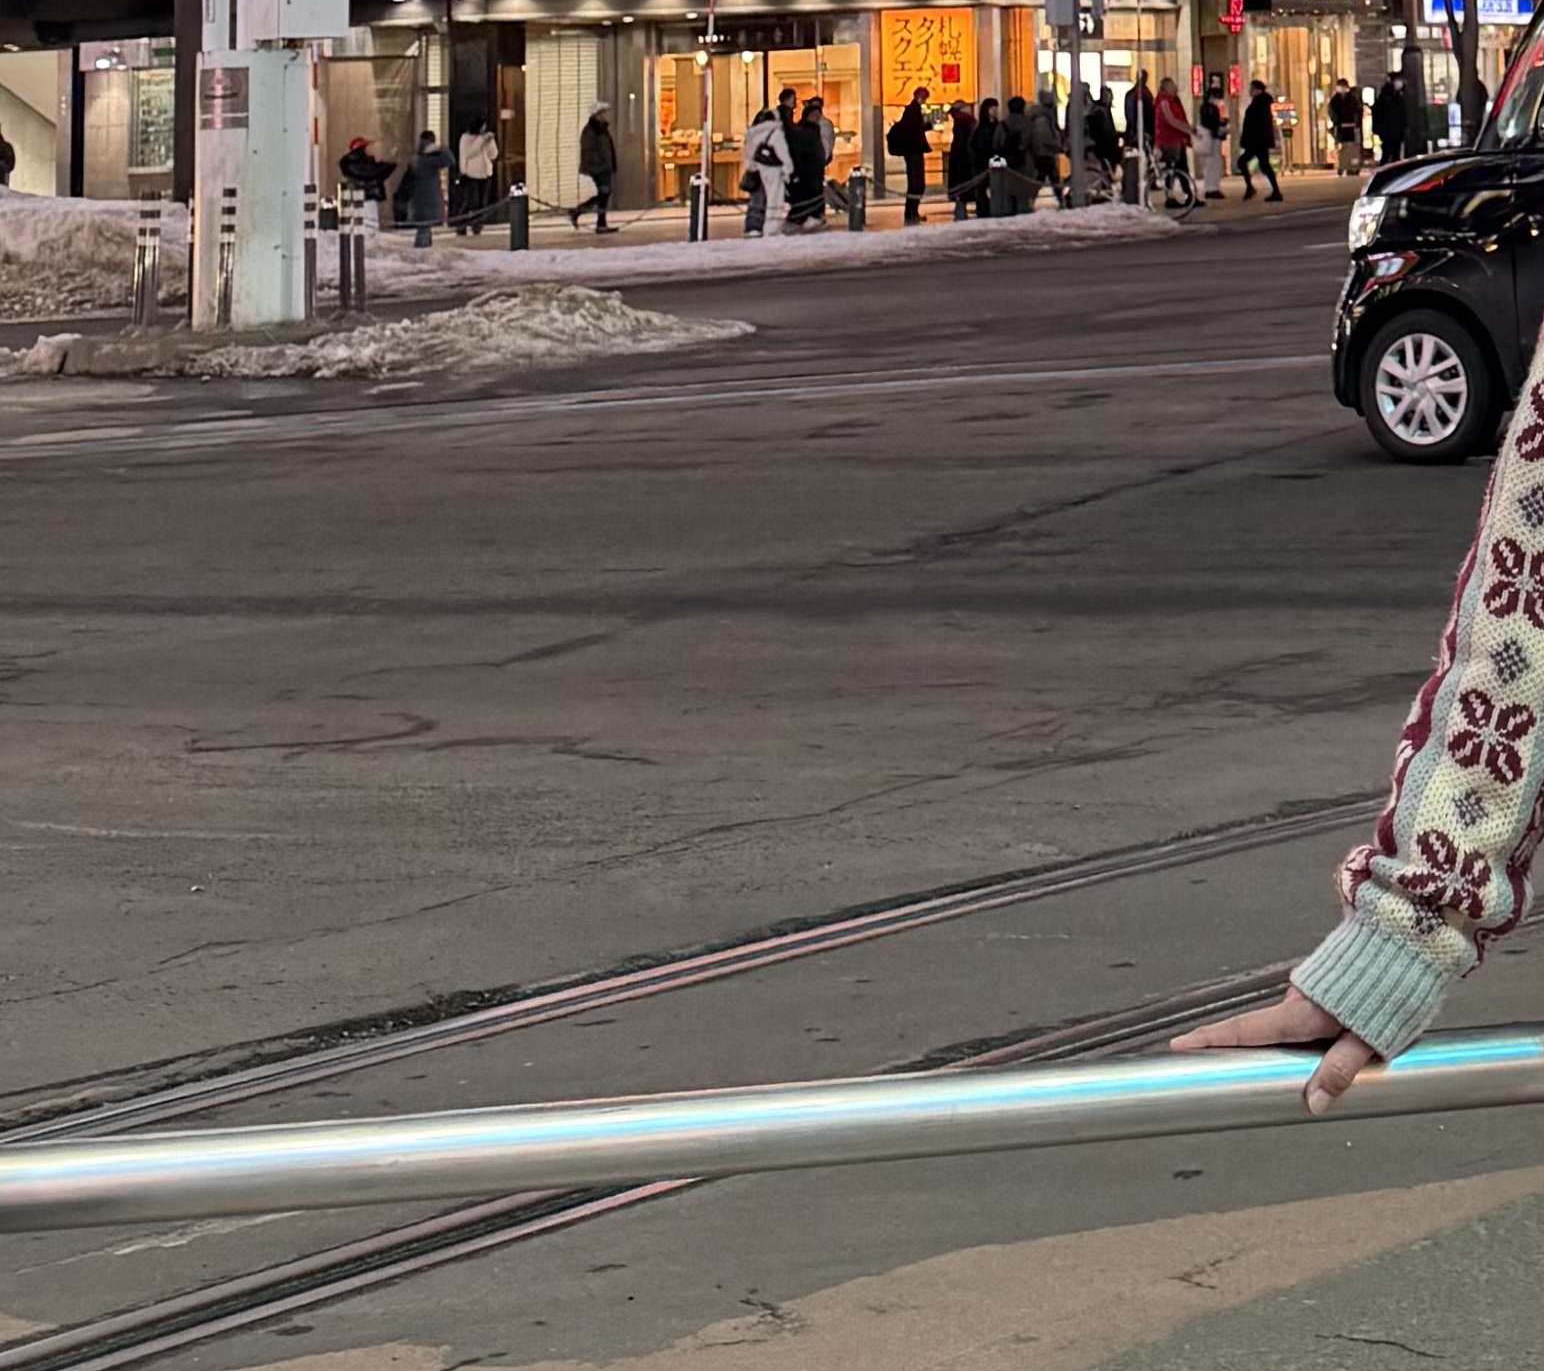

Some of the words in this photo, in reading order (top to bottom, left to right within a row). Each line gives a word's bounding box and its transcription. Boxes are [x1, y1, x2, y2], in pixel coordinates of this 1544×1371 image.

[891, 17, 913, 98] スクエア
[938, 15, 962, 61] 札幌
